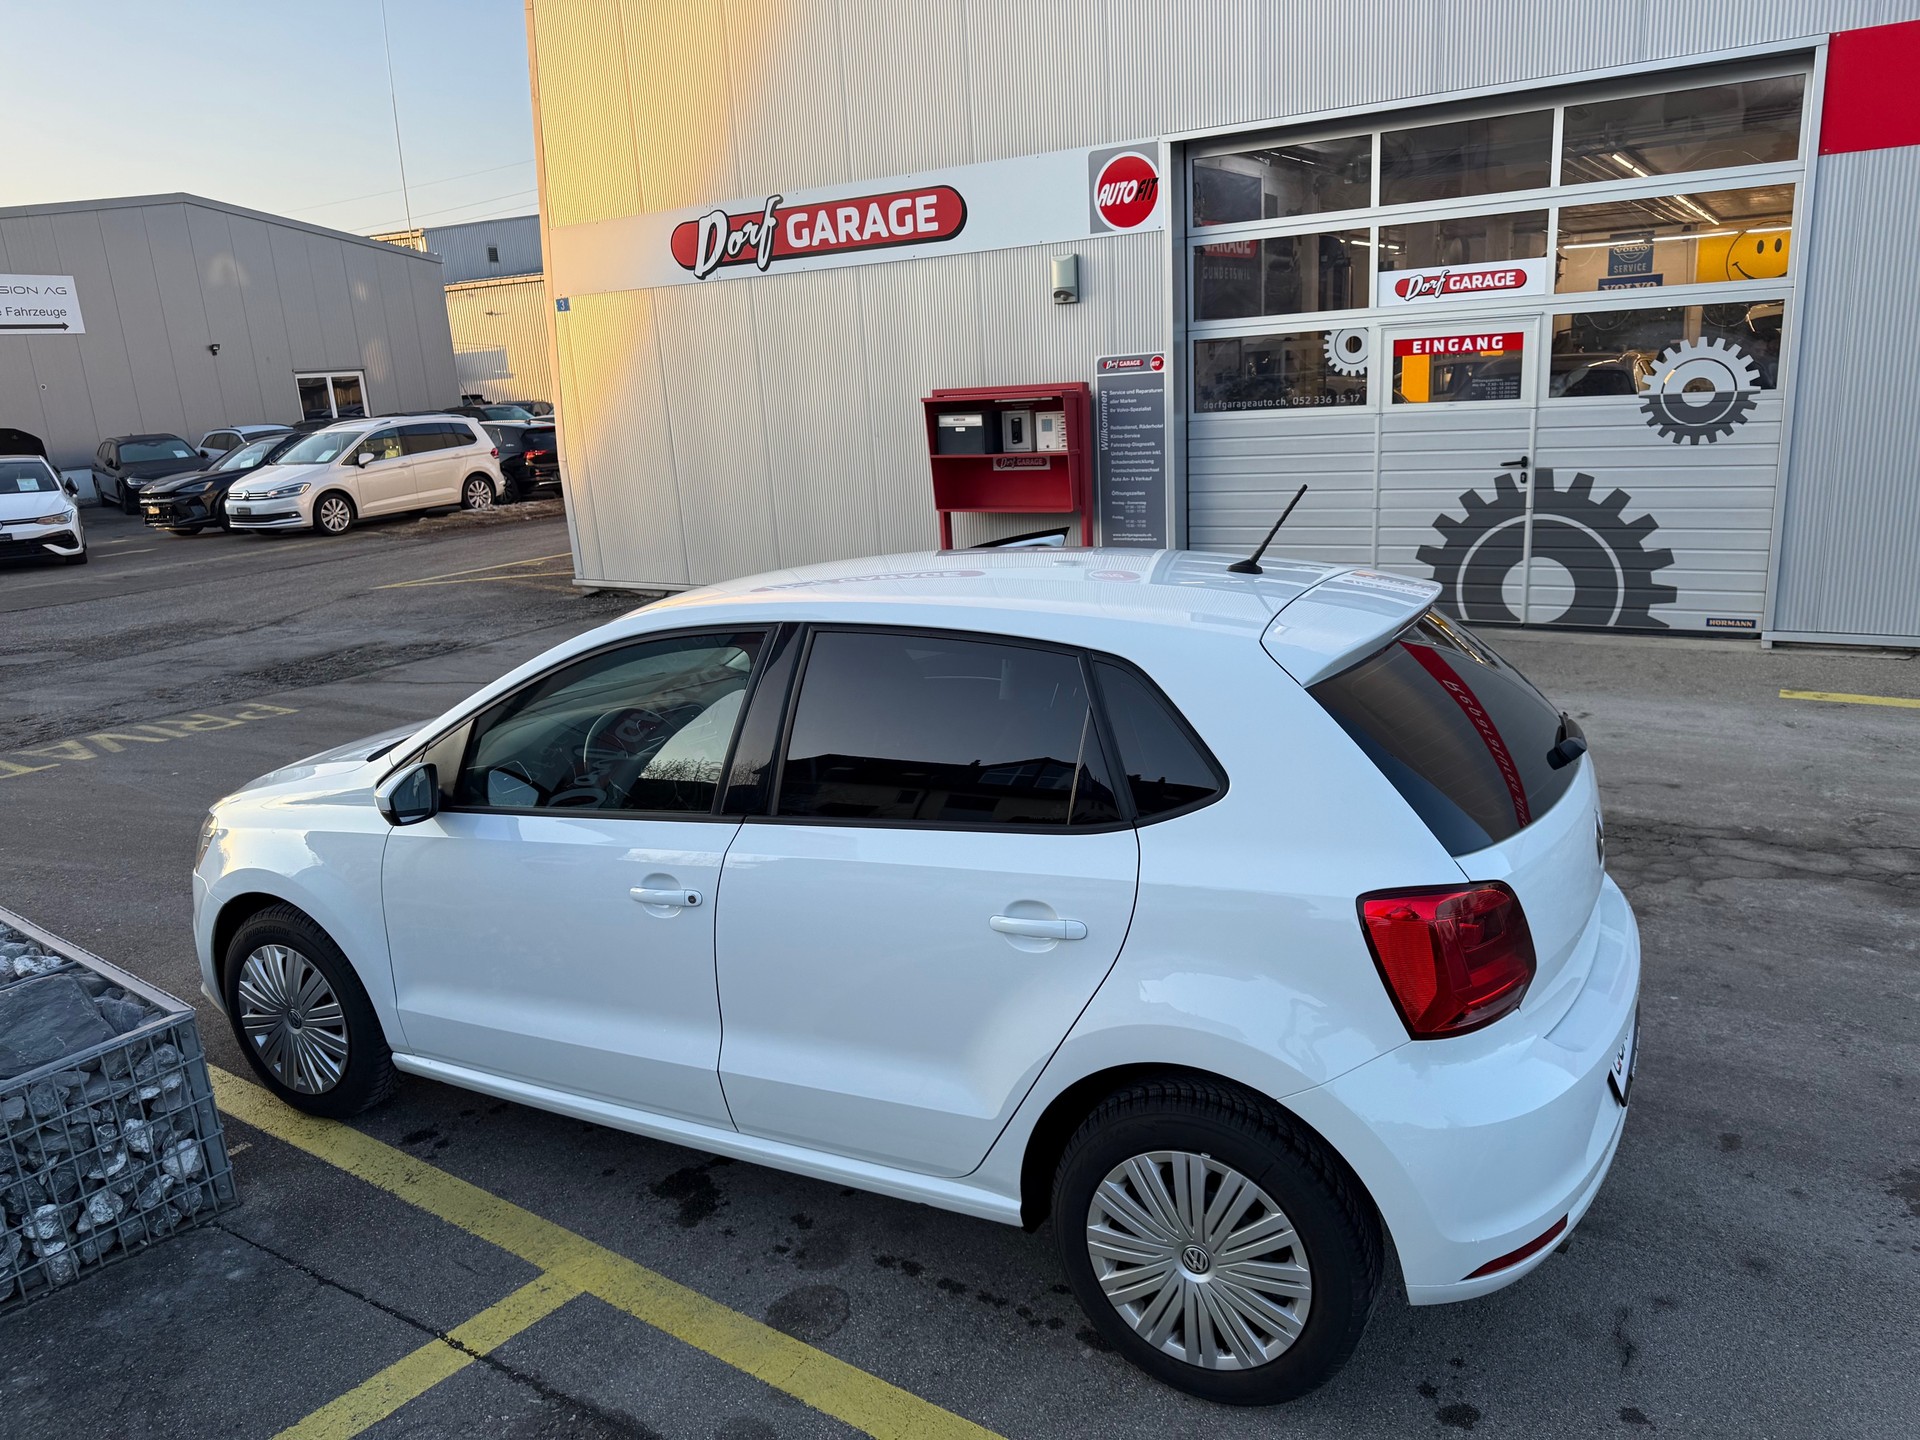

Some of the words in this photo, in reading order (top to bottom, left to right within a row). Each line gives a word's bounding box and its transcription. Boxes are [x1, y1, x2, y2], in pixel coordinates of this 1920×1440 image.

[694, 194, 783, 280] Dorf
[786, 194, 939, 249] GARAGE
[1613, 262, 1647, 274] SERVICE
[43, 286, 67, 295] AG
[1404, 269, 1450, 301] Dorf
[1449, 271, 1516, 290] GARAGE
[5, 306, 67, 319] Fahrzeuge
[1412, 335, 1504, 354] EINGANG
[1119, 359, 1141, 367] GARAGE
[1203, 397, 1289, 411] dorfgarageauto.ch,
[1292, 395, 1311, 406] 052
[1314, 395, 1332, 404] 336
[1335, 394, 1346, 403] 15
[1350, 393, 1361, 403] 17
[1100, 390, 1109, 451] Willkommen
[1017, 458, 1043, 466] GARAGE
